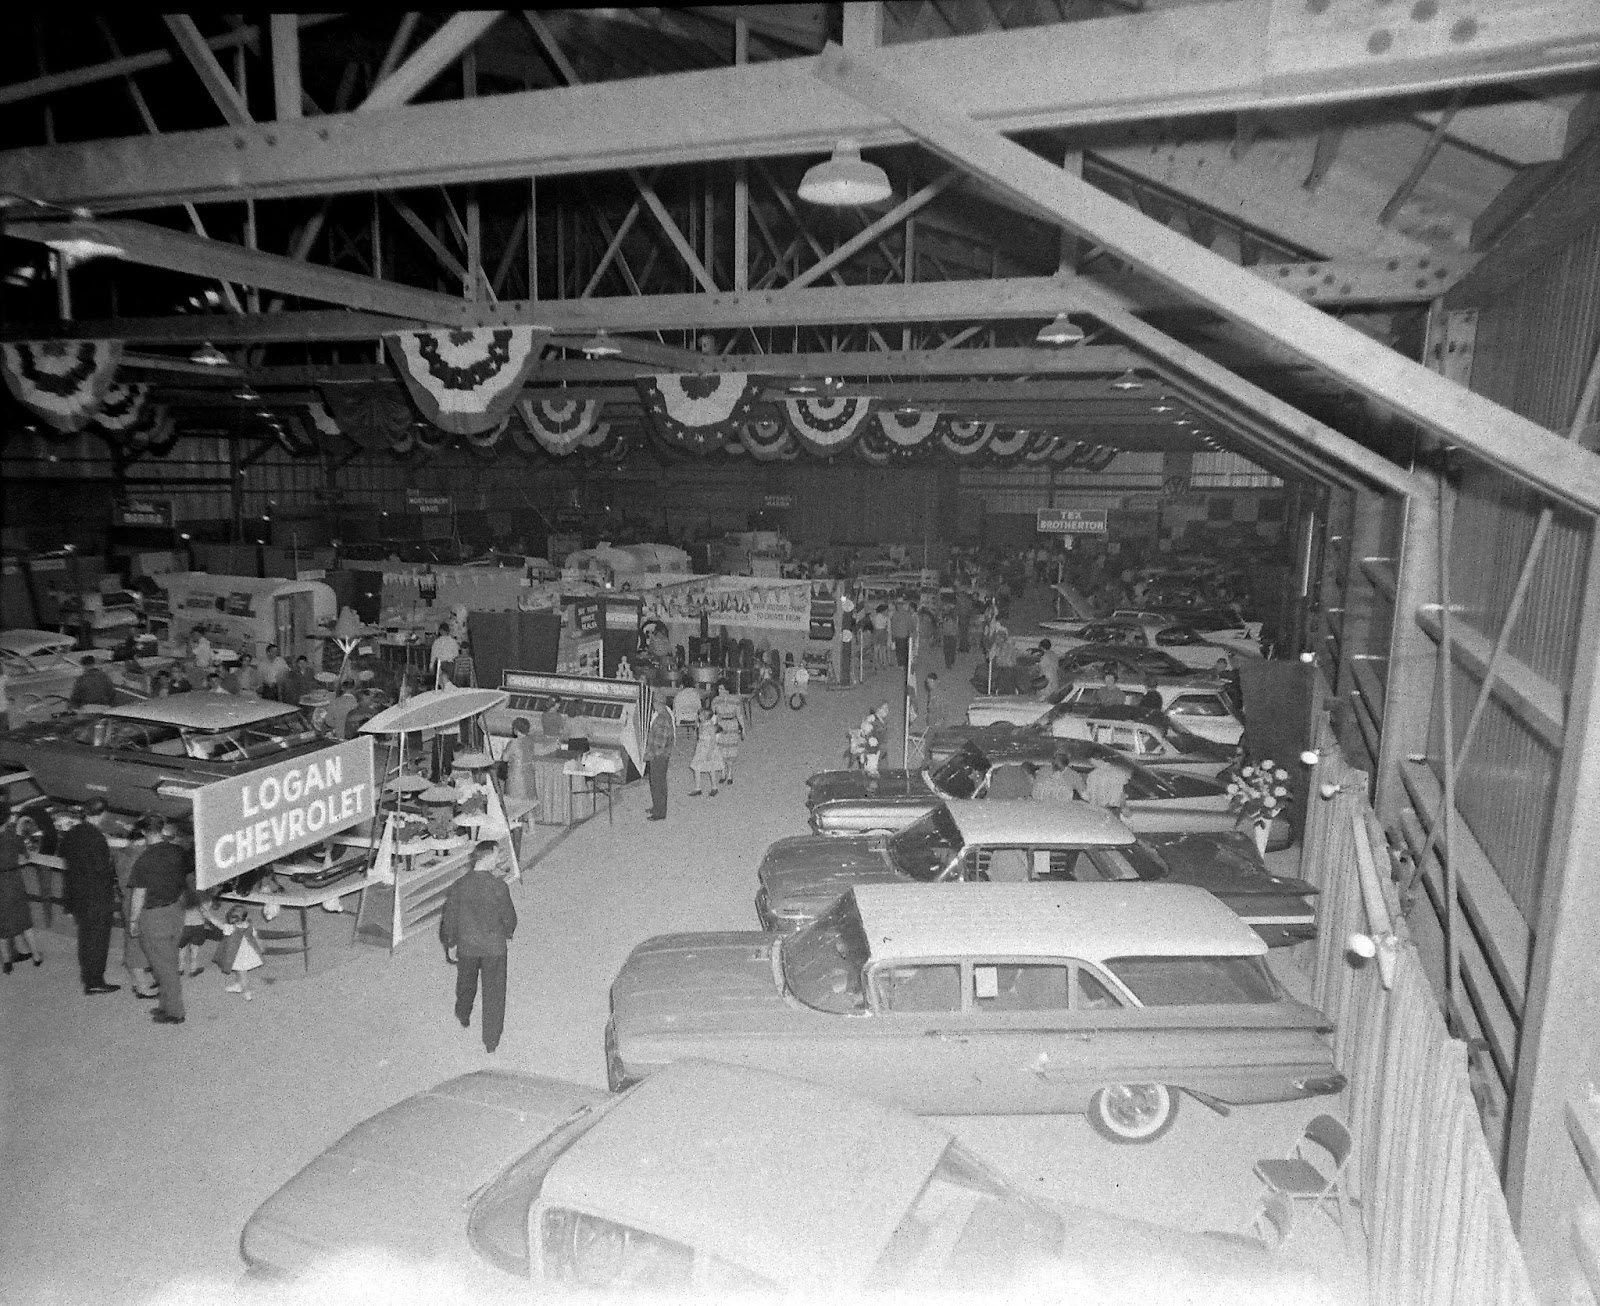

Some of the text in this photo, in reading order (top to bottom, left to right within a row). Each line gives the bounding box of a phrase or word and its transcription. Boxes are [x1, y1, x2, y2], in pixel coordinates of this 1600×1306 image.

[1040, 520, 1104, 531] BROTHERTON
[1060, 511, 1082, 520] TEX
[241, 755, 342, 818] LOGAN
[213, 782, 366, 869] CHEVROLET
